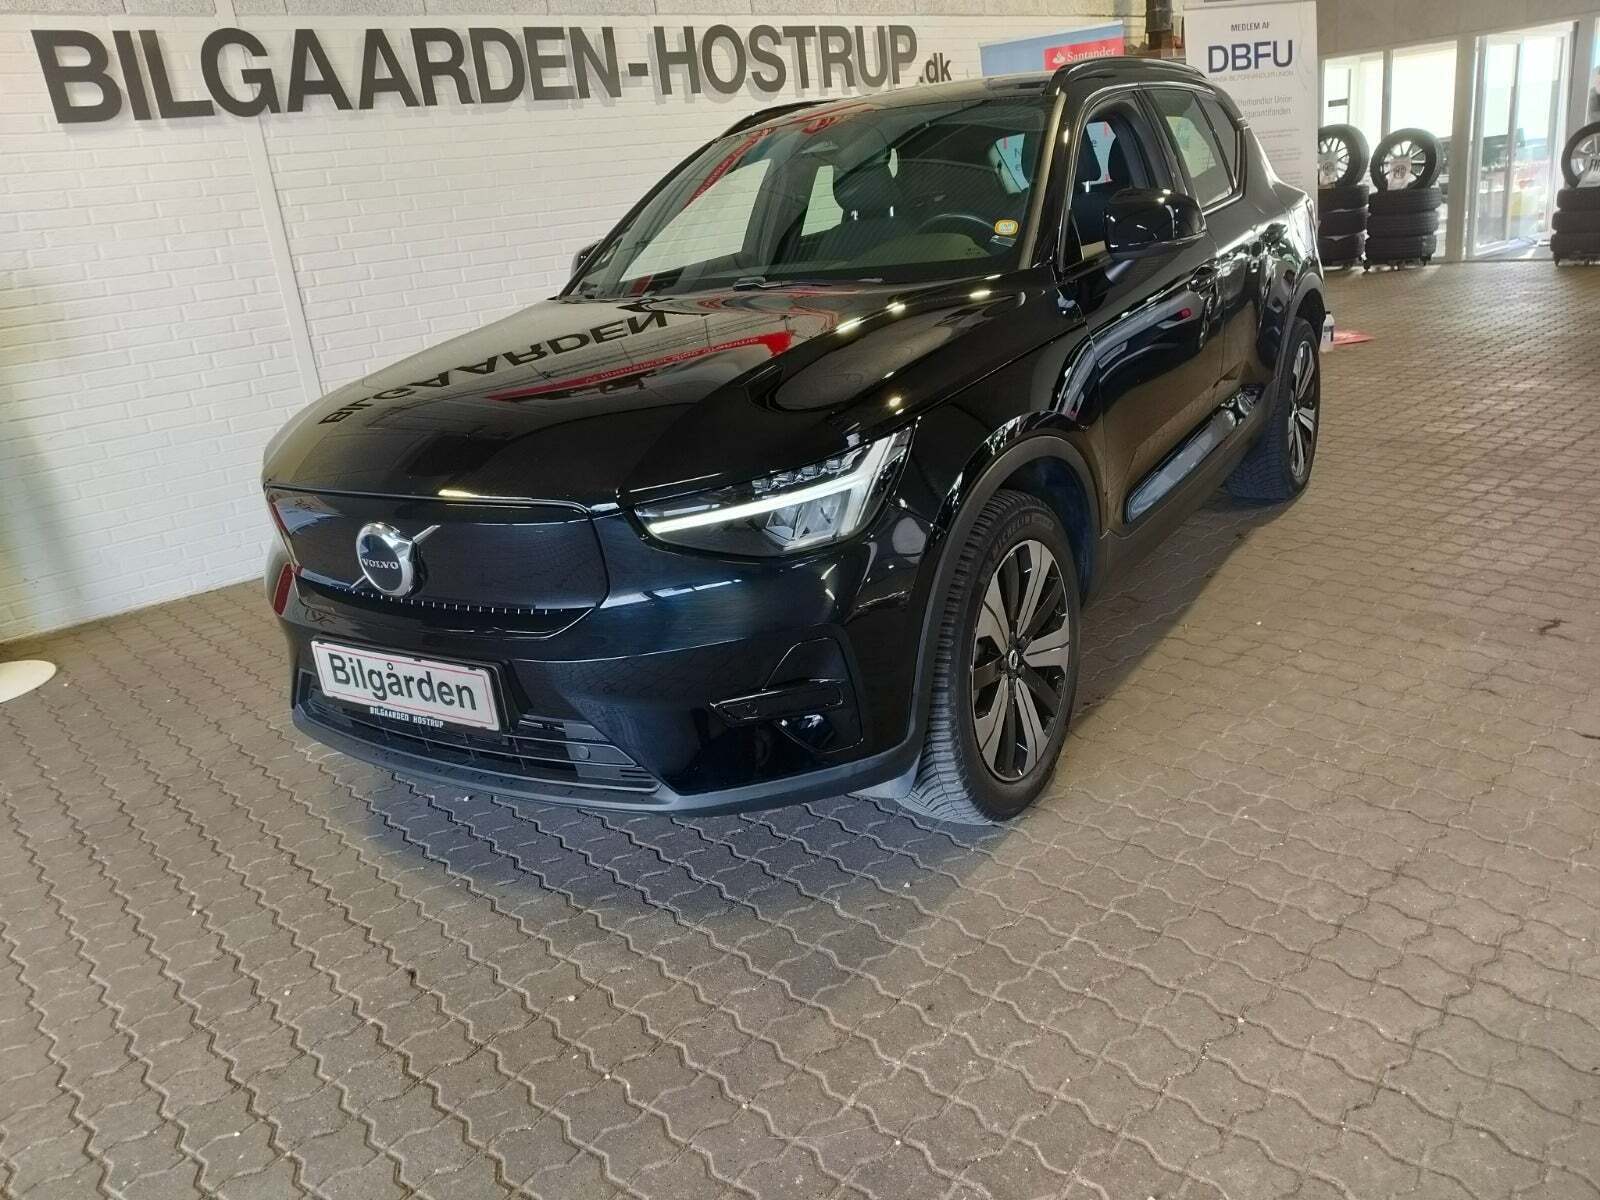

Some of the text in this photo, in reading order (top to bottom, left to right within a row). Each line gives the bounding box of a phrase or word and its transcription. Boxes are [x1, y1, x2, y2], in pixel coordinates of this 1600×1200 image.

[1231, 23, 1261, 32] MEDLEM
[1067, 46, 1116, 62] Santander
[1208, 40, 1293, 73] DBFU
[362, 558, 399, 570] VOLVO
[328, 653, 477, 710] Bilgården
[369, 706, 444, 729] BILGAARDEN HOSTRUP
